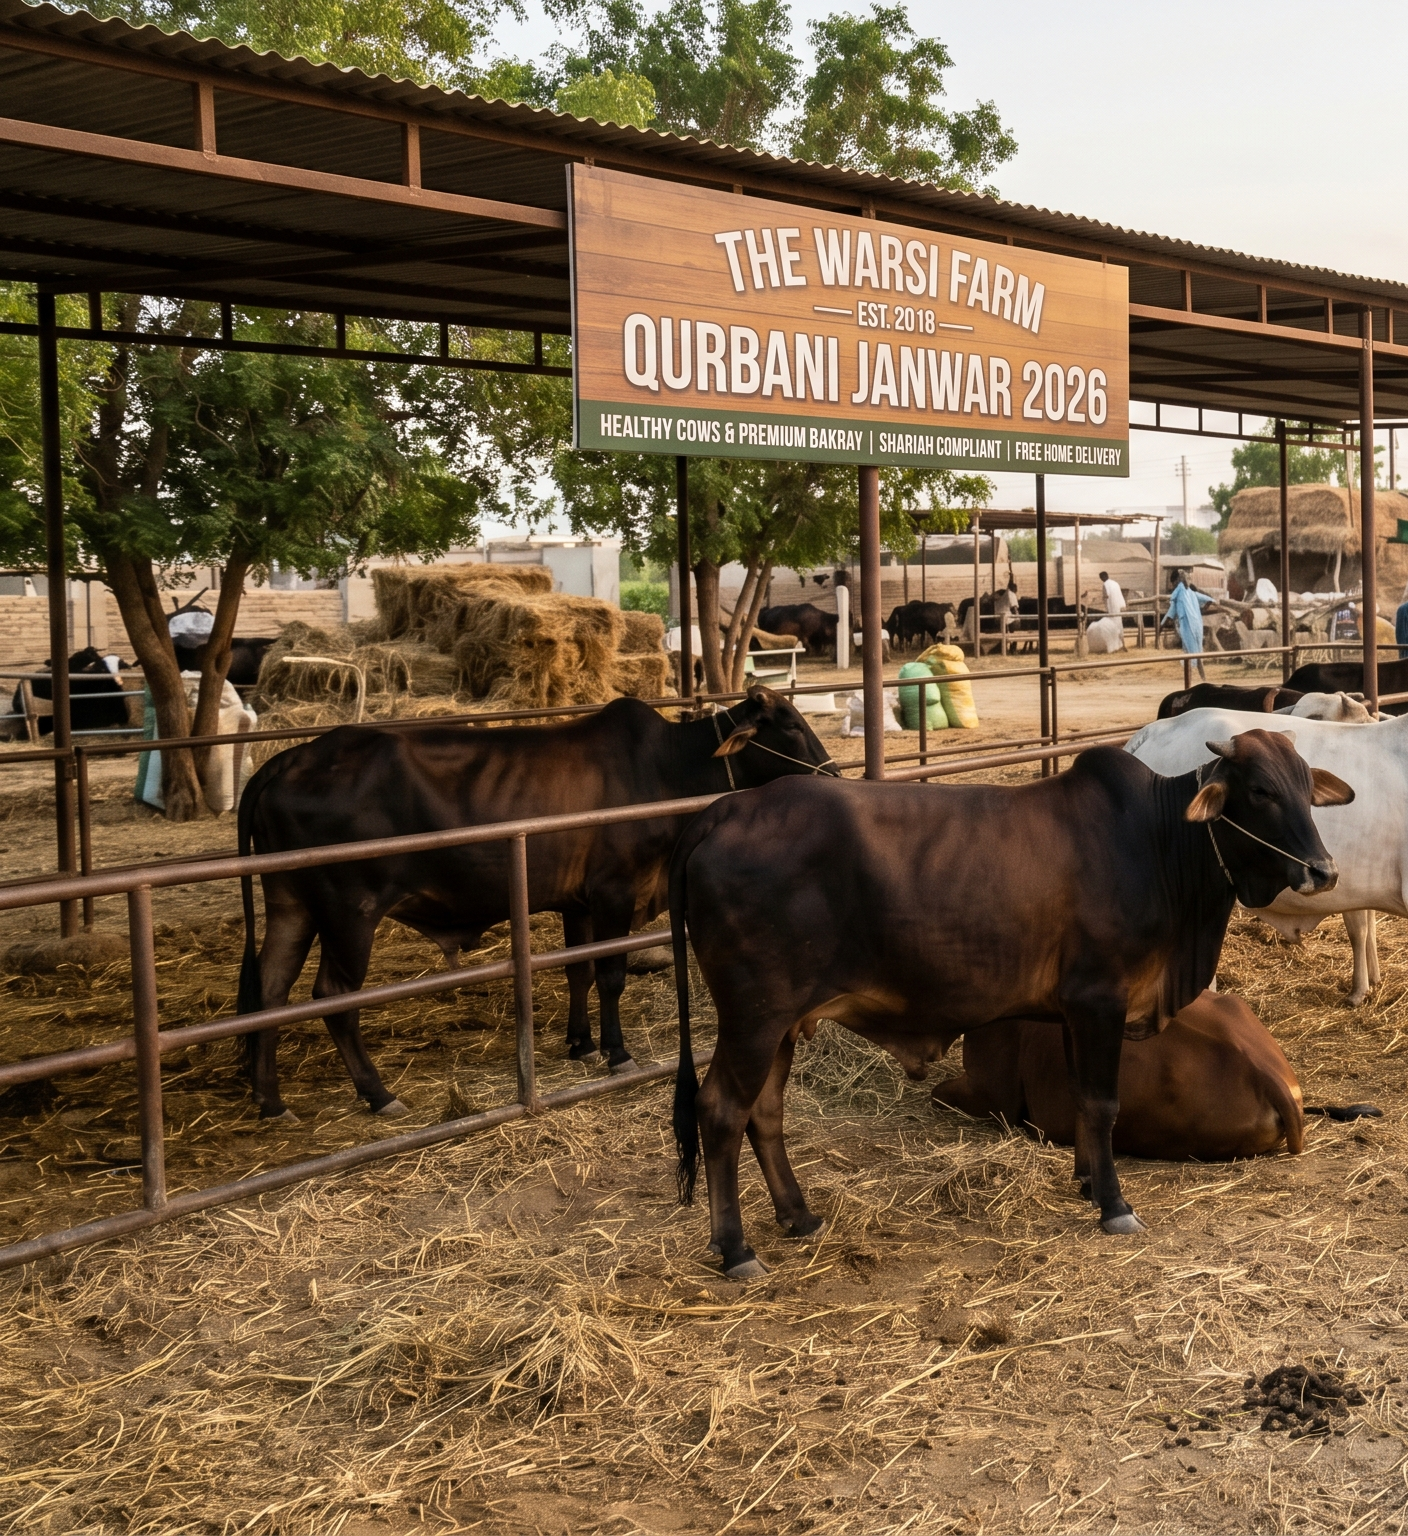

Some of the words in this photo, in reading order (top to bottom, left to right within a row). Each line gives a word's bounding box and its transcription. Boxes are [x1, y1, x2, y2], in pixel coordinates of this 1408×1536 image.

[714, 227, 807, 292] THE
[813, 227, 939, 298] WARSI
[949, 249, 1045, 334] FARM
[858, 301, 891, 329] EST.
[894, 305, 936, 334] 2018
[624, 313, 839, 402] QURBANI
[852, 340, 1012, 417] JANWAR
[1022, 360, 1107, 425] 2026
[600, 413, 673, 440] HEALTHY
[676, 418, 721, 443] COWS
[724, 422, 735, 444] &
[738, 422, 806, 448] PREMIUM
[809, 427, 863, 451] BAKRAY
[879, 432, 934, 456] SHARIAH
[936, 436, 1002, 459] COMPLIANT
[1015, 441, 1042, 461] FREE
[1044, 443, 1074, 463] HOME
[1075, 445, 1122, 466] DELIVERY
